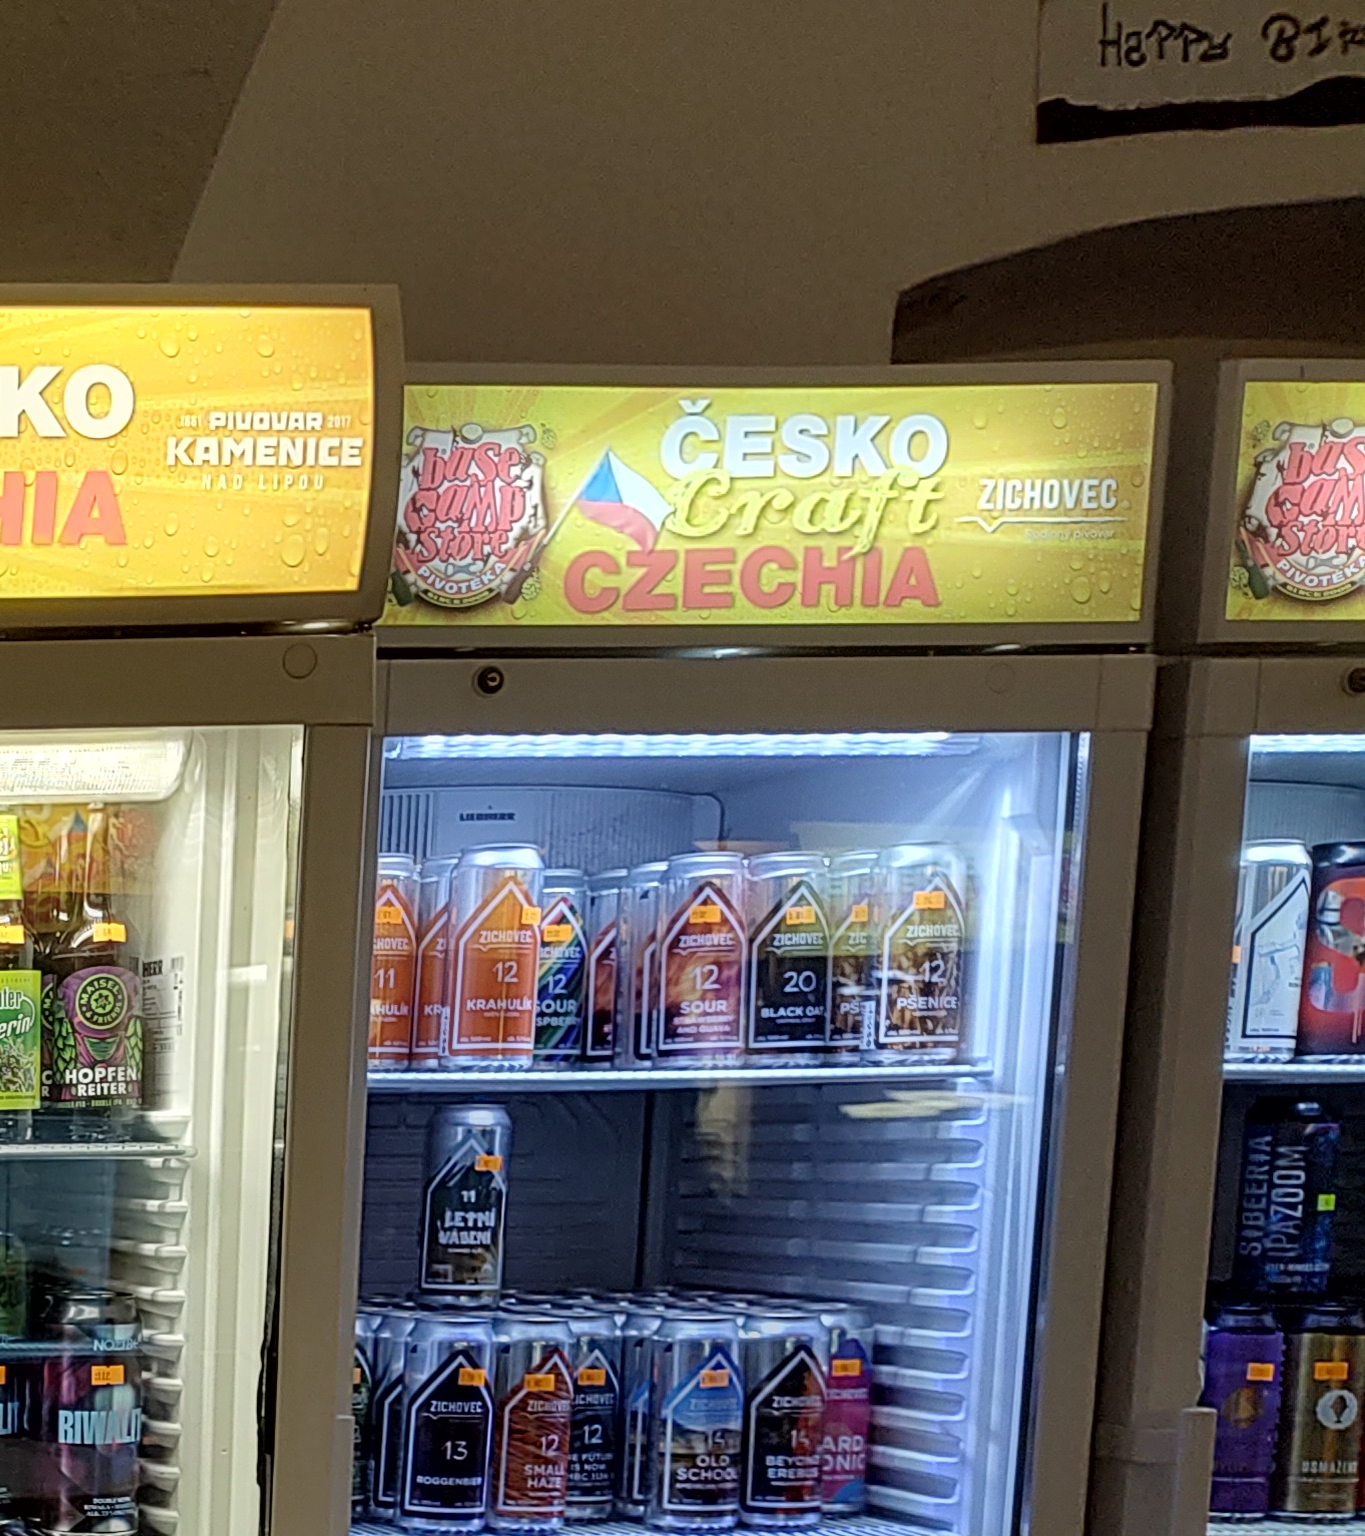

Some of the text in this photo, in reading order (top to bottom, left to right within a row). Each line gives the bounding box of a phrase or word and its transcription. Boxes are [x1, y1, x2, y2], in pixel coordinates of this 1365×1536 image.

[661, 399, 949, 479] ČESKO
[166, 436, 364, 467] KAMENICE
[202, 474, 324, 490] NAD LIPOU
[977, 478, 1117, 510] ZICHOVEC
[667, 465, 943, 553] Craft
[563, 546, 939, 611] CZECHIA
[479, 930, 533, 944] ZICHOVEC
[492, 961, 519, 984] 12
[690, 965, 722, 990] 12
[782, 970, 817, 993] 20
[679, 1000, 727, 1015] SOUR
[760, 1006, 804, 1019] BLACK
[66, 1065, 138, 1083] HOPFEN
[76, 1082, 127, 1096] REITER
[429, 1400, 483, 1413] ZICHOVEC
[440, 1440, 468, 1461] 13
[696, 1455, 731, 1467] OLD
